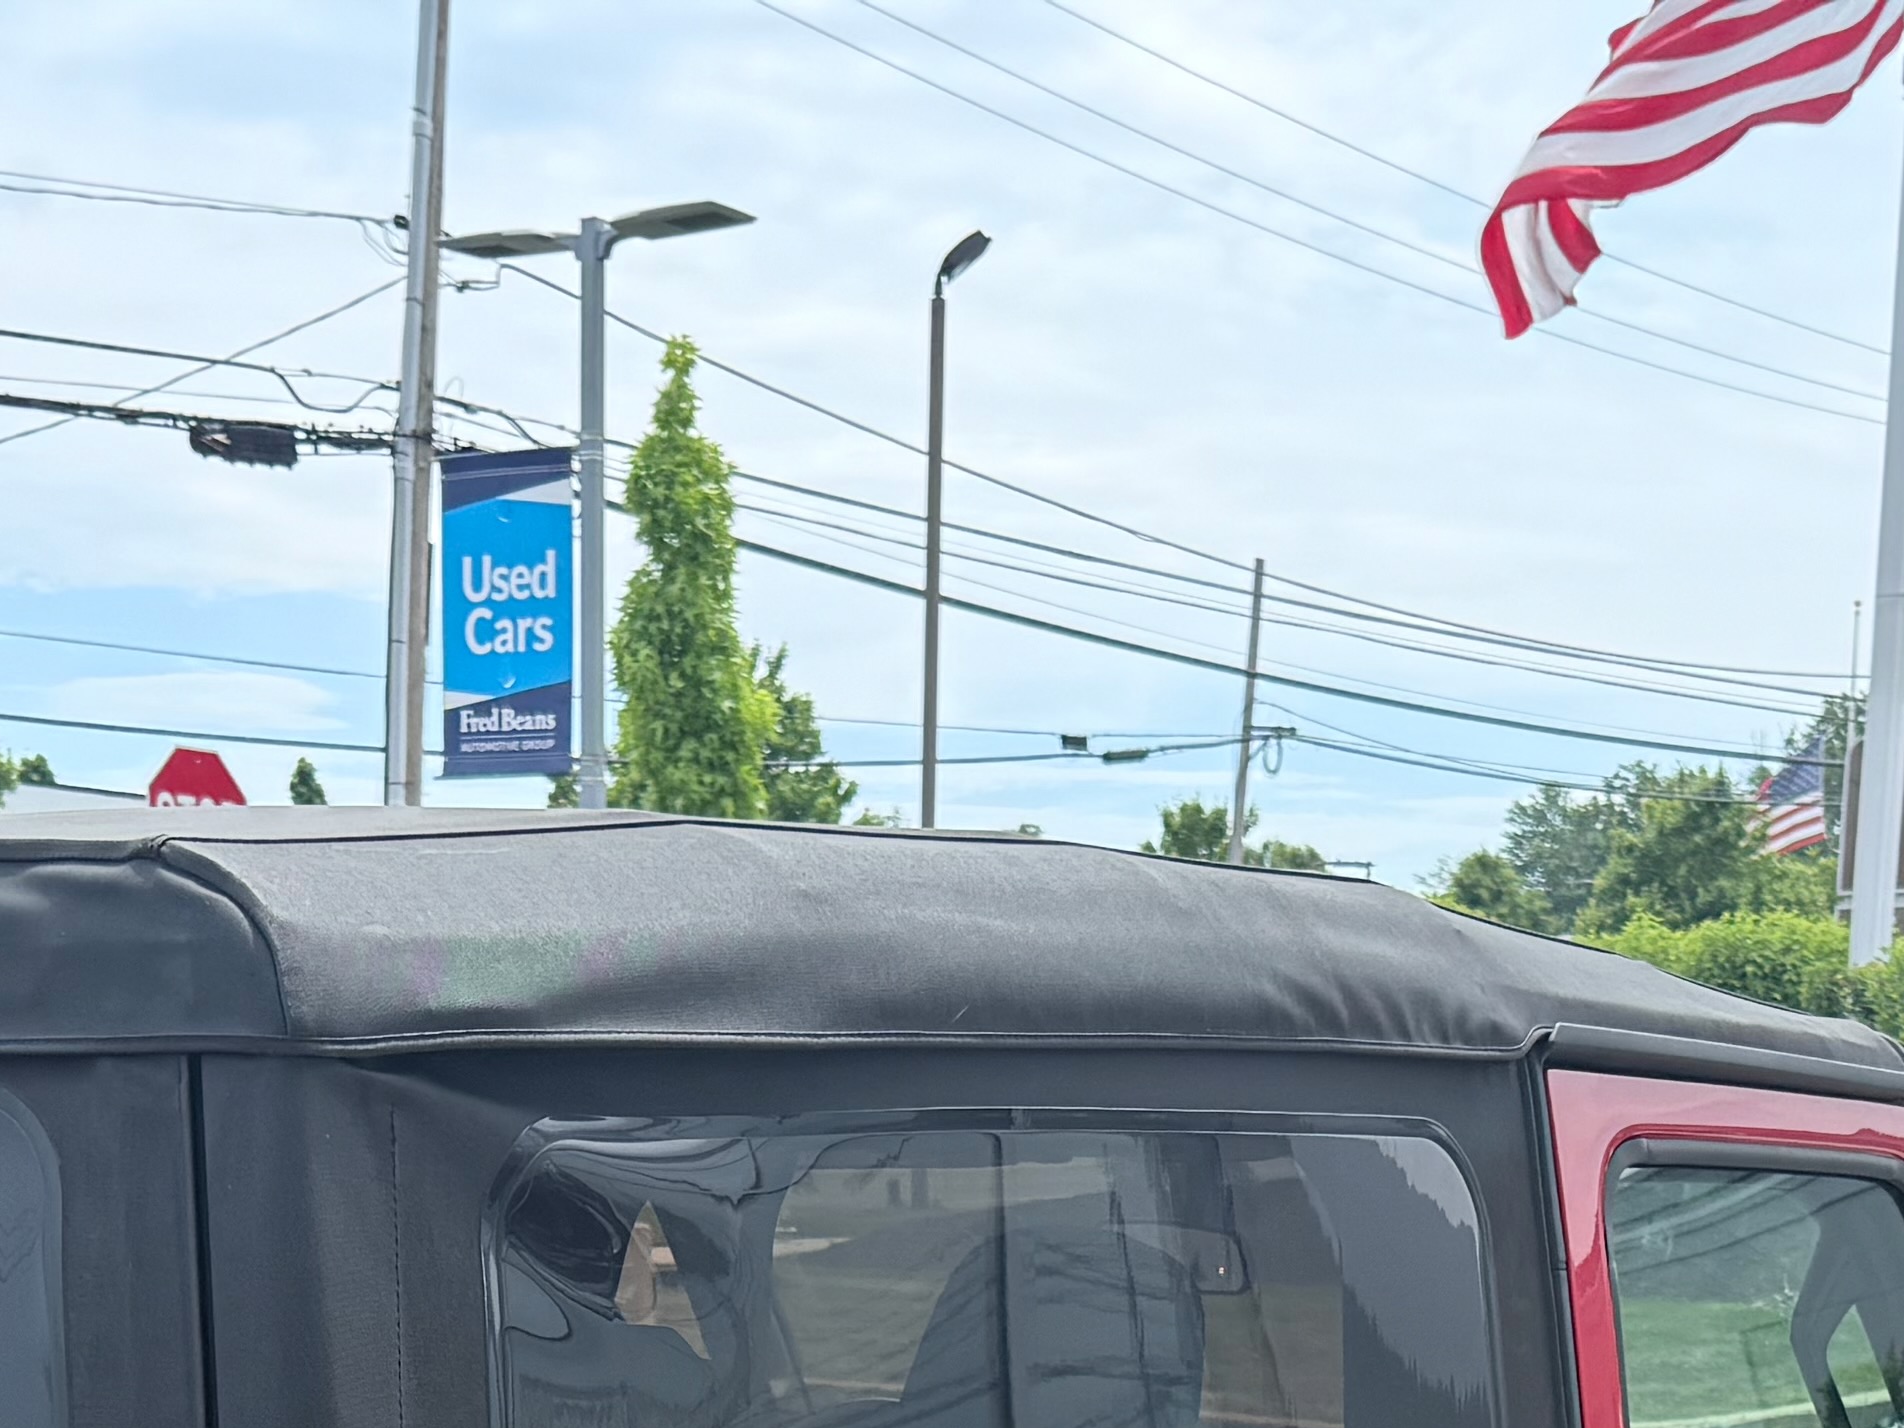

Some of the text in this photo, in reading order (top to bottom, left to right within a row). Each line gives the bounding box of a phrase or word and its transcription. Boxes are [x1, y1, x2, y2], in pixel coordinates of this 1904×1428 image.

[462, 550, 556, 603] Used
[464, 608, 555, 655] Cars
[459, 708, 556, 733] Fred Beans
